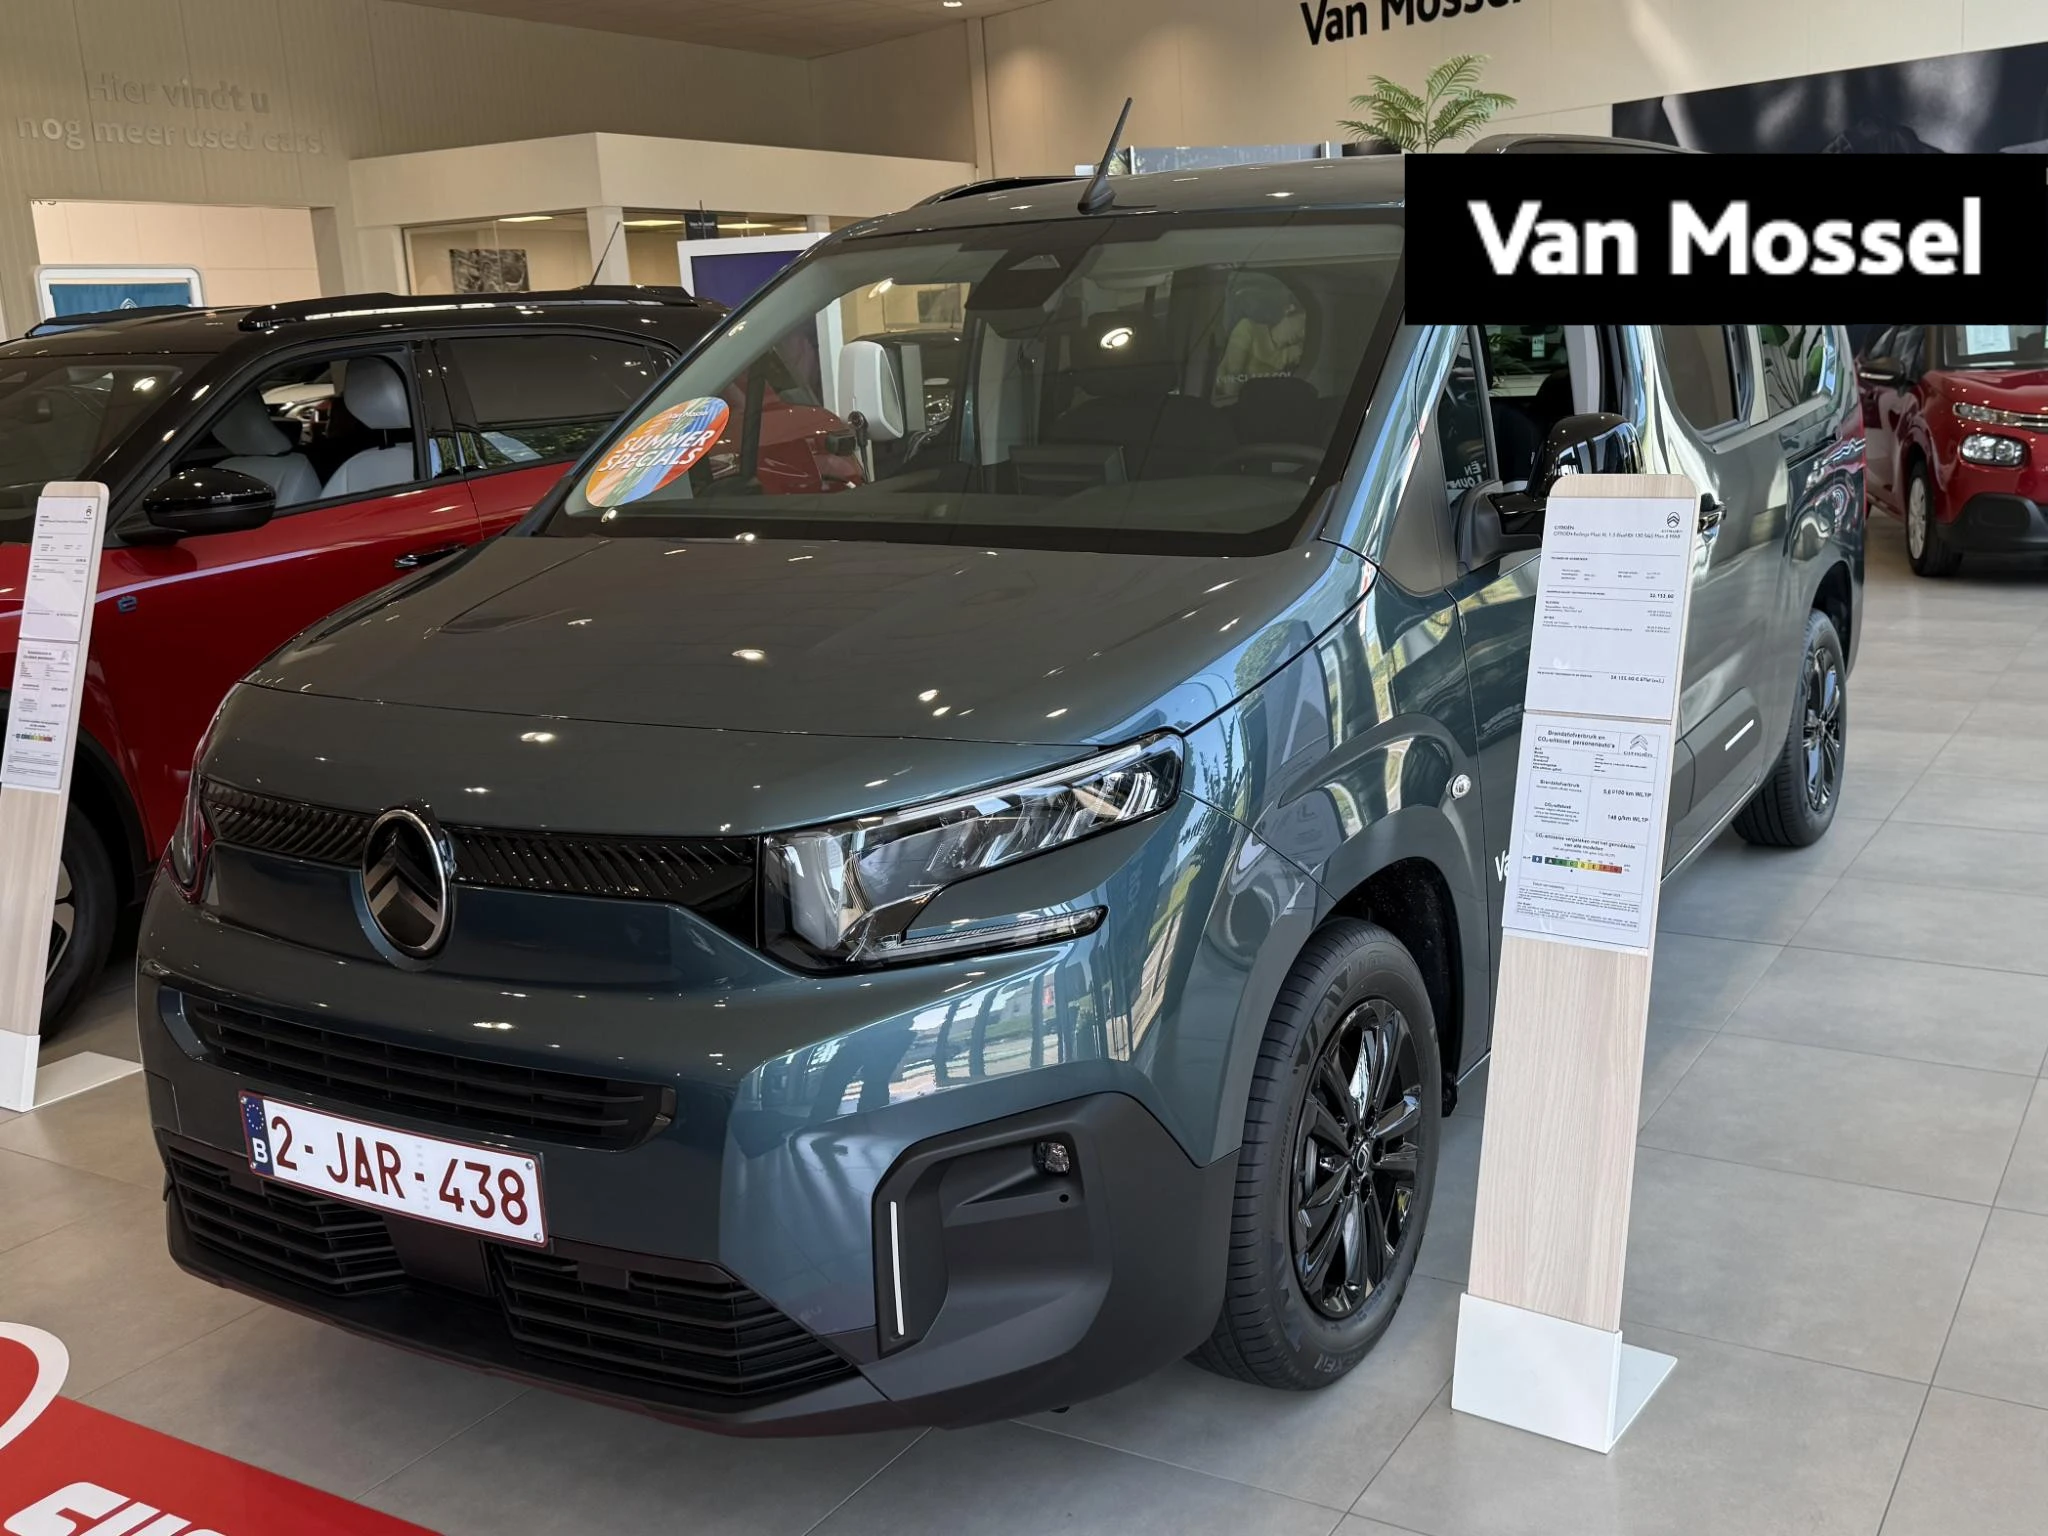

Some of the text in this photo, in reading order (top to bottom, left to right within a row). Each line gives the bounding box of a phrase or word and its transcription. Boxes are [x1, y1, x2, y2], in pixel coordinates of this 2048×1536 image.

[1300, 0, 1367, 45] Van
[89, 73, 271, 114] Hier vindt u
[16, 116, 86, 151] nog
[92, 121, 176, 147] meer
[182, 120, 255, 150] used
[615, 430, 715, 454] SUMMER
[597, 448, 703, 472] SPECIALS
[252, 1137, 269, 1164] B
